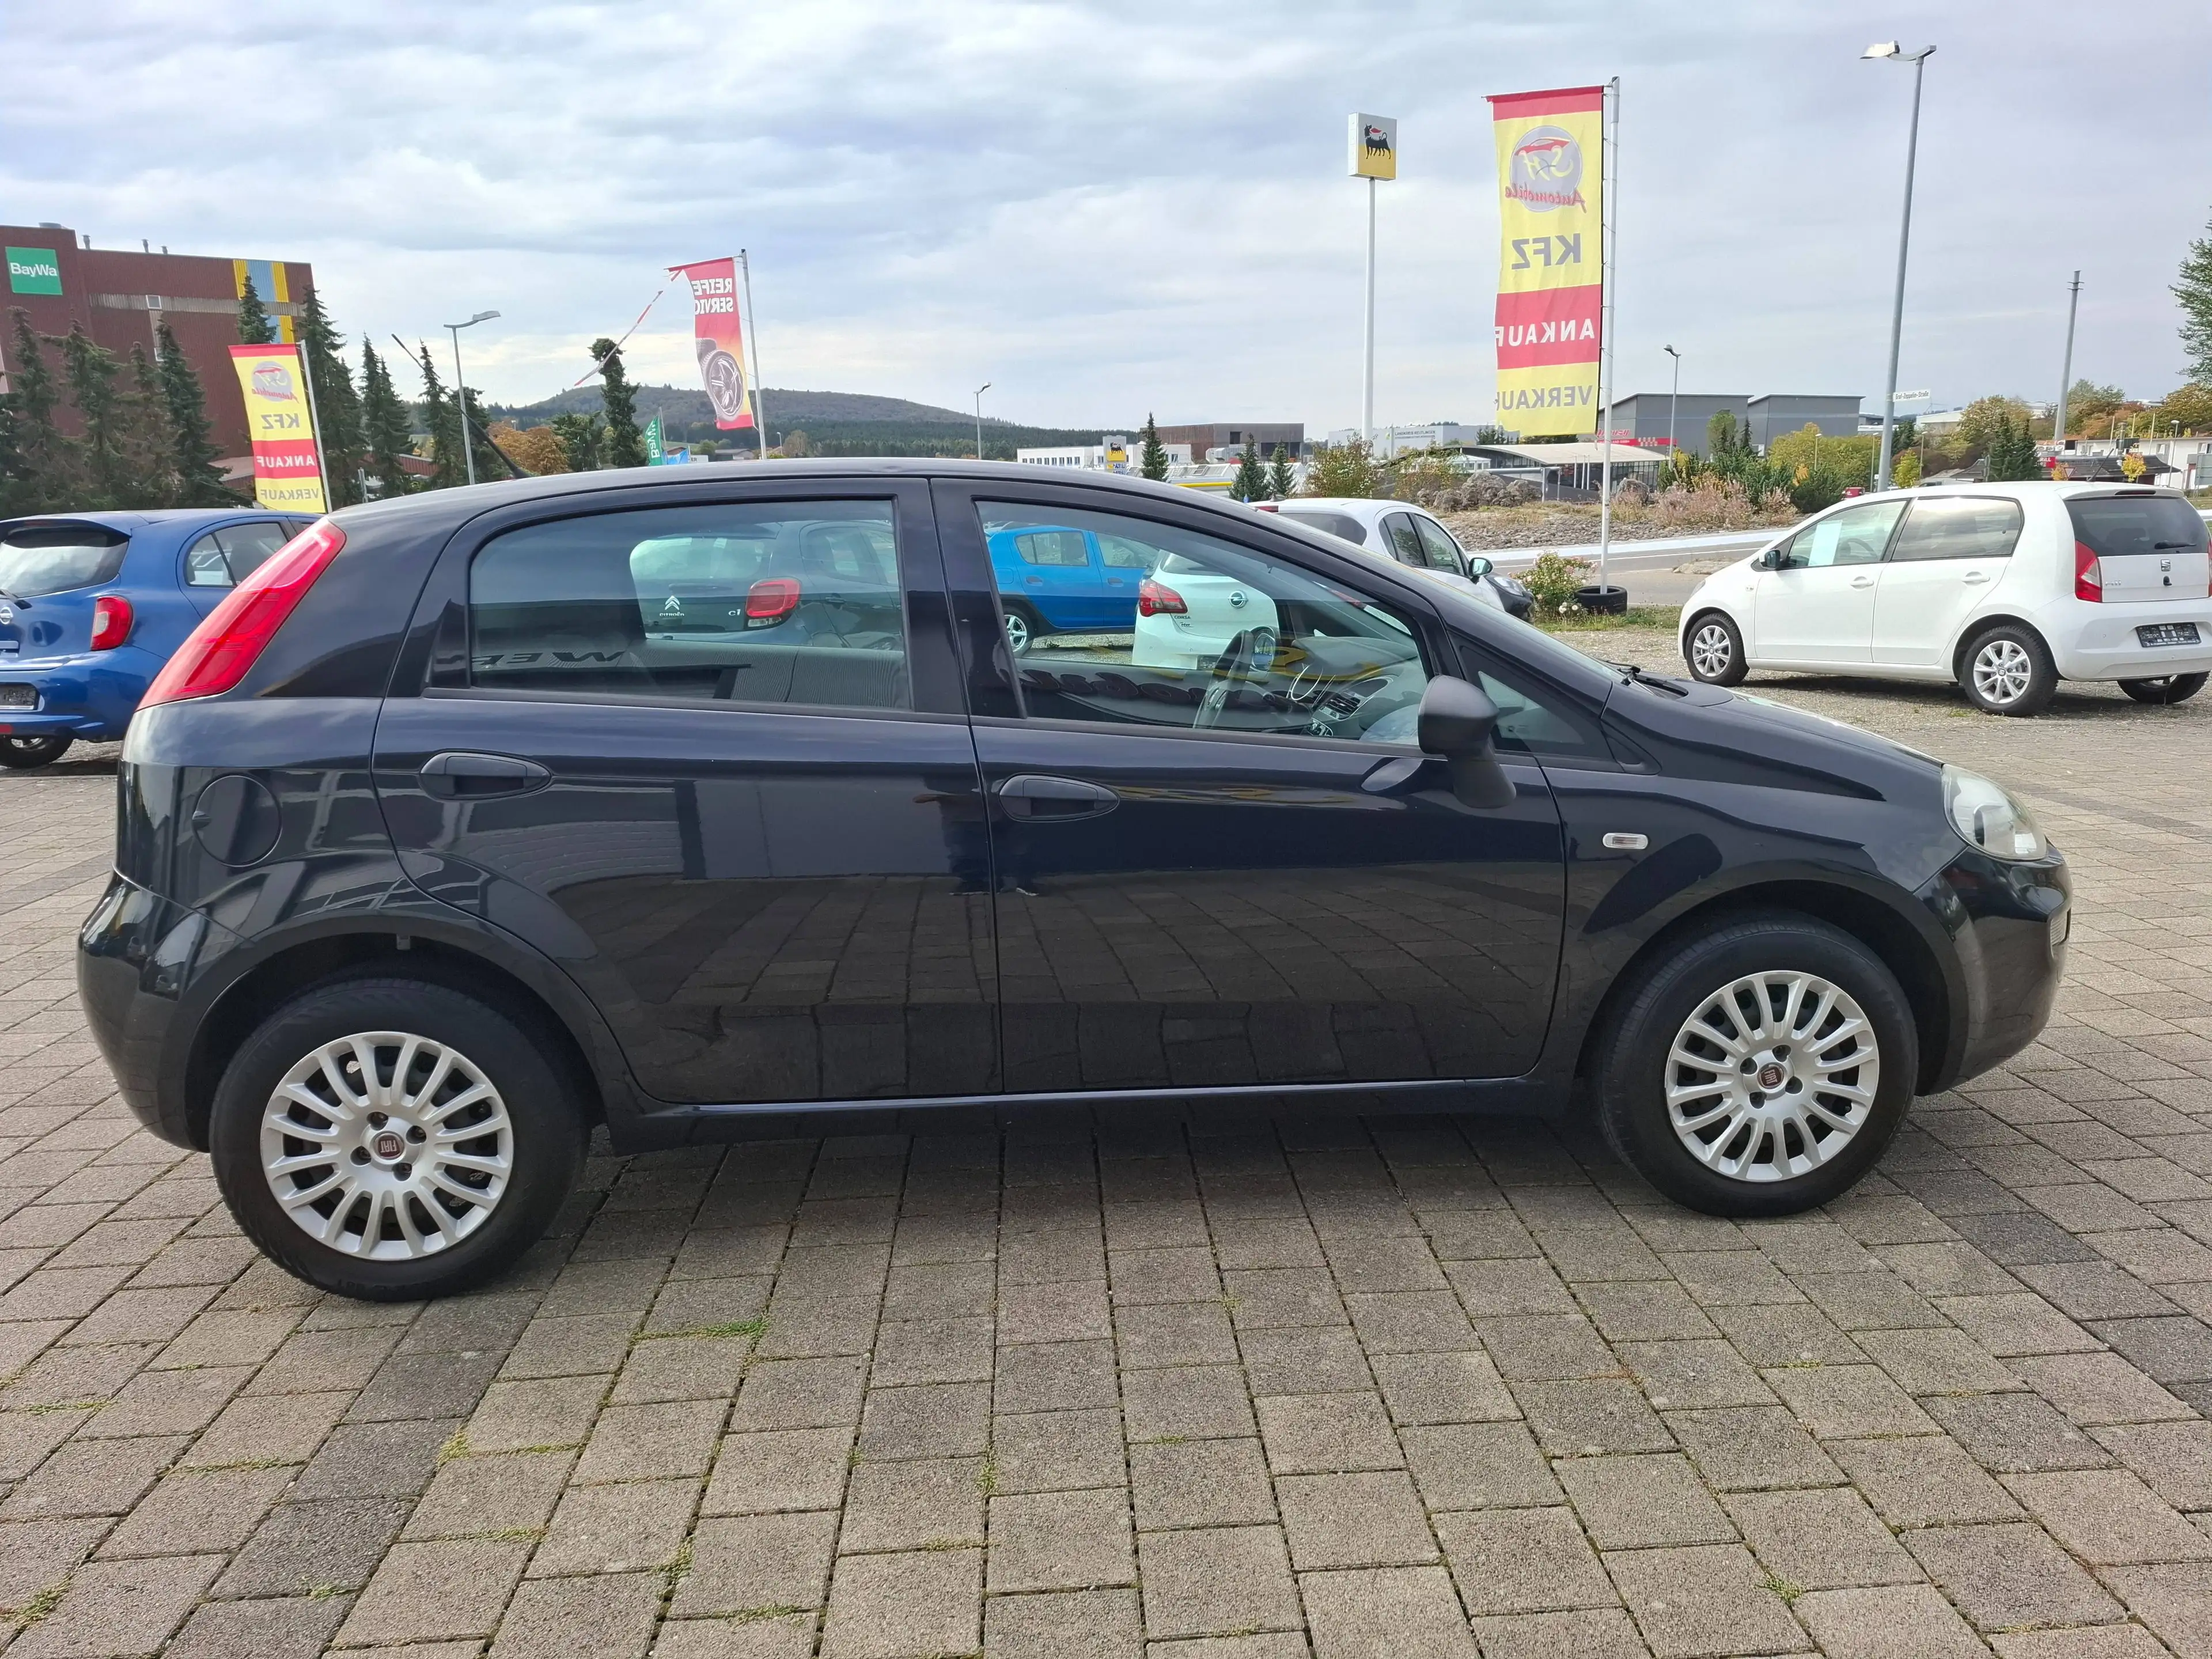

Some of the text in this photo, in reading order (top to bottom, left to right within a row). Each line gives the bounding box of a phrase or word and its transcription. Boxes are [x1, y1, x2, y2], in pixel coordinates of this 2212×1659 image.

[10, 262, 58, 278] BayWa
[1764, 1069, 1778, 1084] FIAT
[380, 1139, 398, 1153] FIAT
